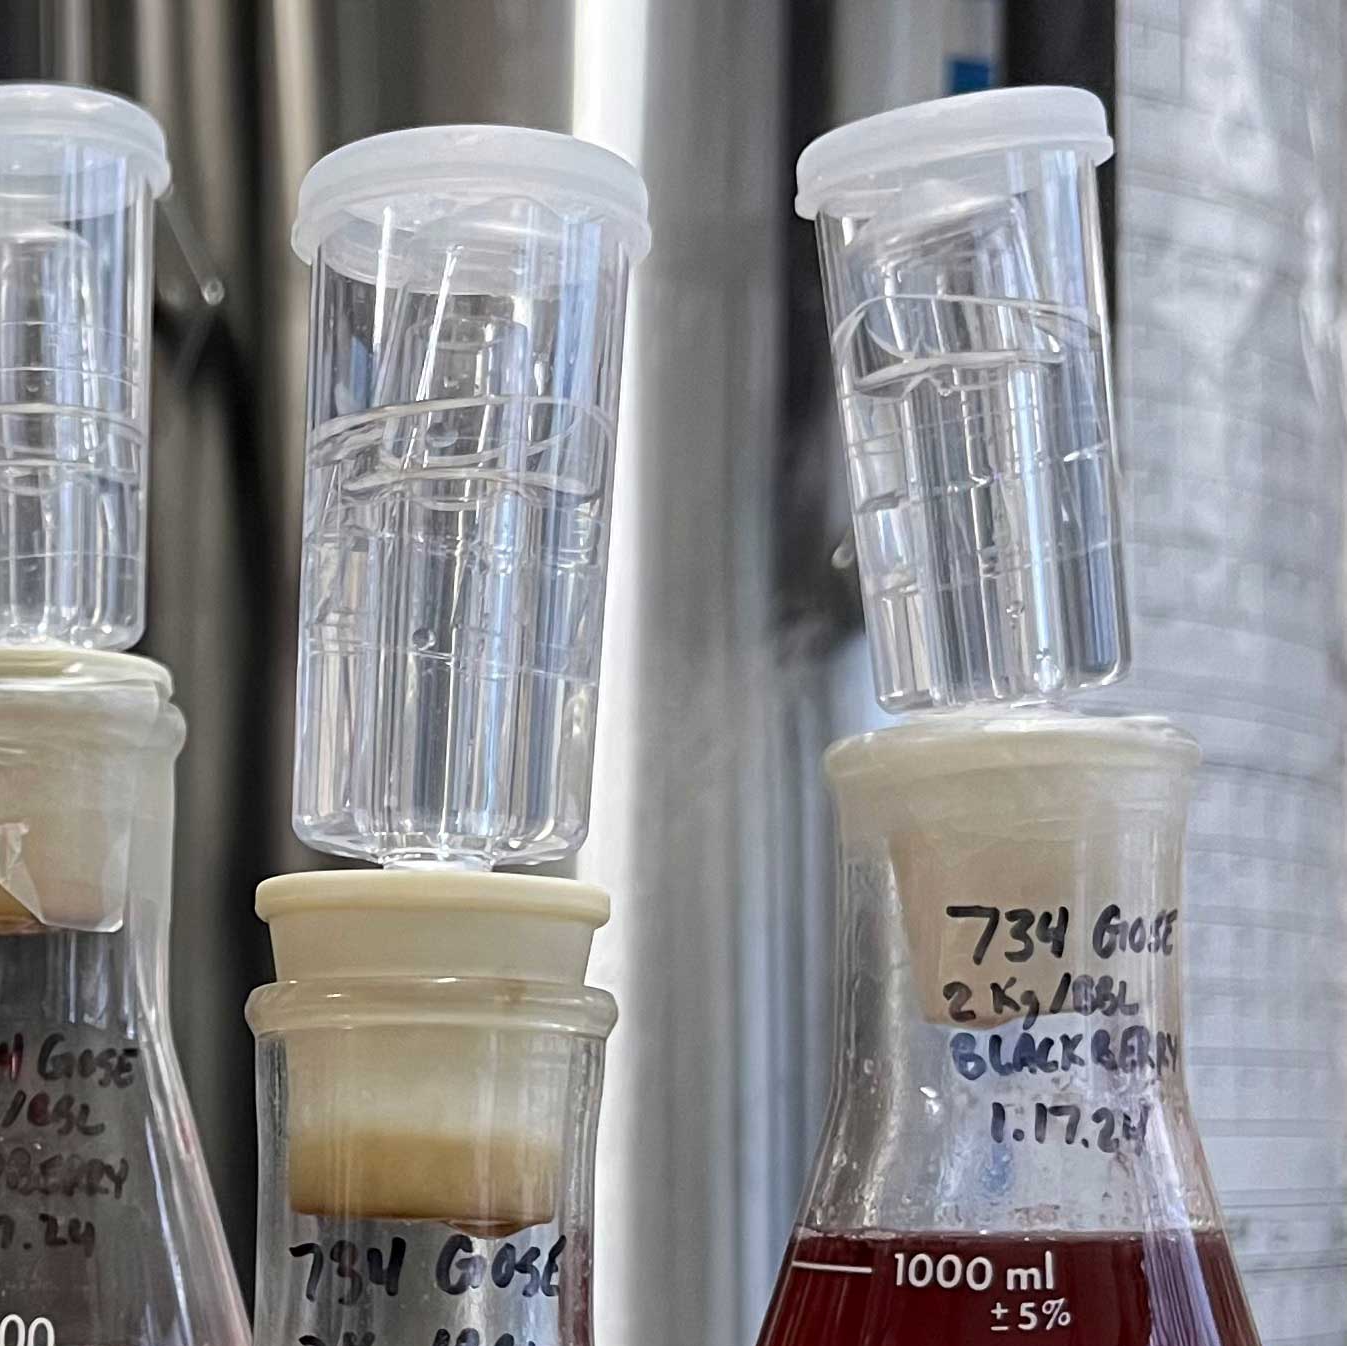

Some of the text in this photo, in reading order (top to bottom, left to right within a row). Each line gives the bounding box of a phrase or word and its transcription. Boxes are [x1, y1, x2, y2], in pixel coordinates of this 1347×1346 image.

[946, 904, 1178, 966] 734 GOSE
[942, 981, 976, 1022] 2
[37, 1032, 138, 1088] GOSE
[290, 1234, 567, 1305] 734 GOSE
[894, 1251, 1055, 1290] 1000 ml
